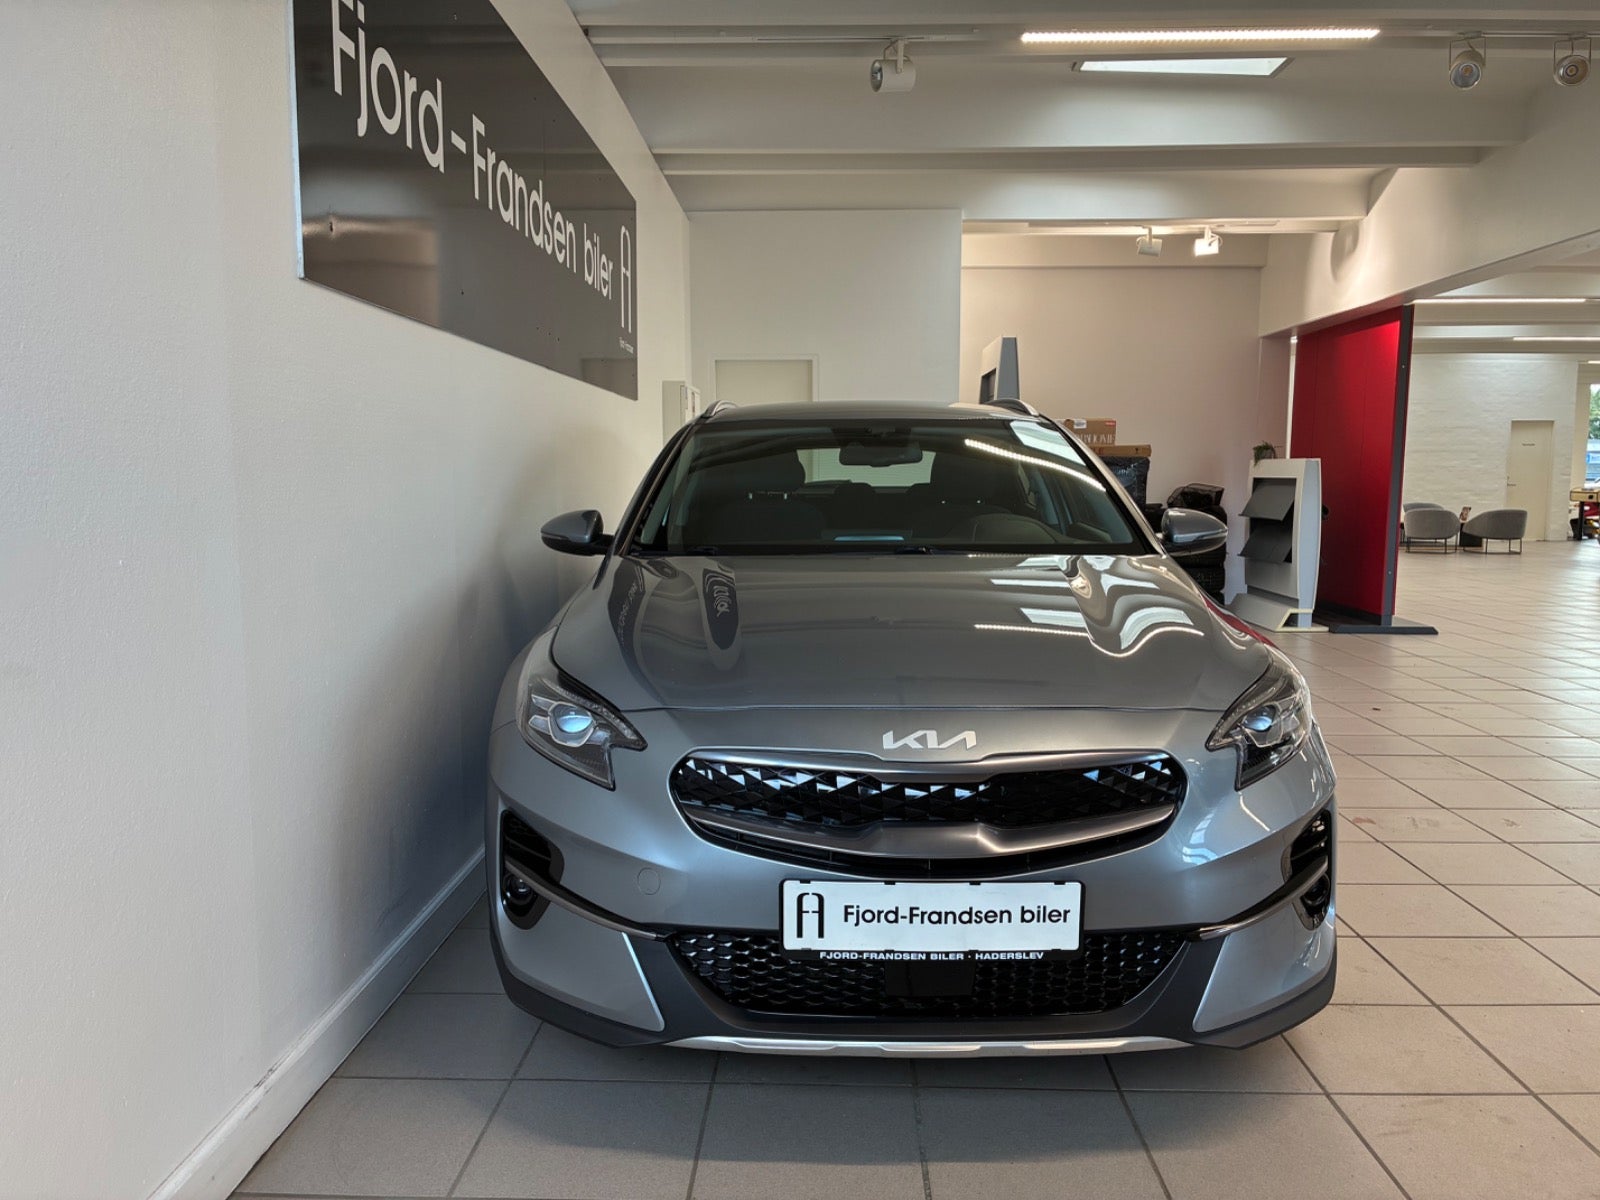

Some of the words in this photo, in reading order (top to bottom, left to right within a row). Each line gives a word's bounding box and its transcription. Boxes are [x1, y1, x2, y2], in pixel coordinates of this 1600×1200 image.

[583, 223, 614, 300] biler
[882, 730, 977, 750] KIA
[843, 905, 1012, 927] Fjord-Frandsen
[1020, 905, 1071, 924] biler
[819, 951, 927, 961] FJORD-FRANDSEN
[930, 952, 964, 961] BILER
[975, 952, 1044, 961] HADERSLEV
